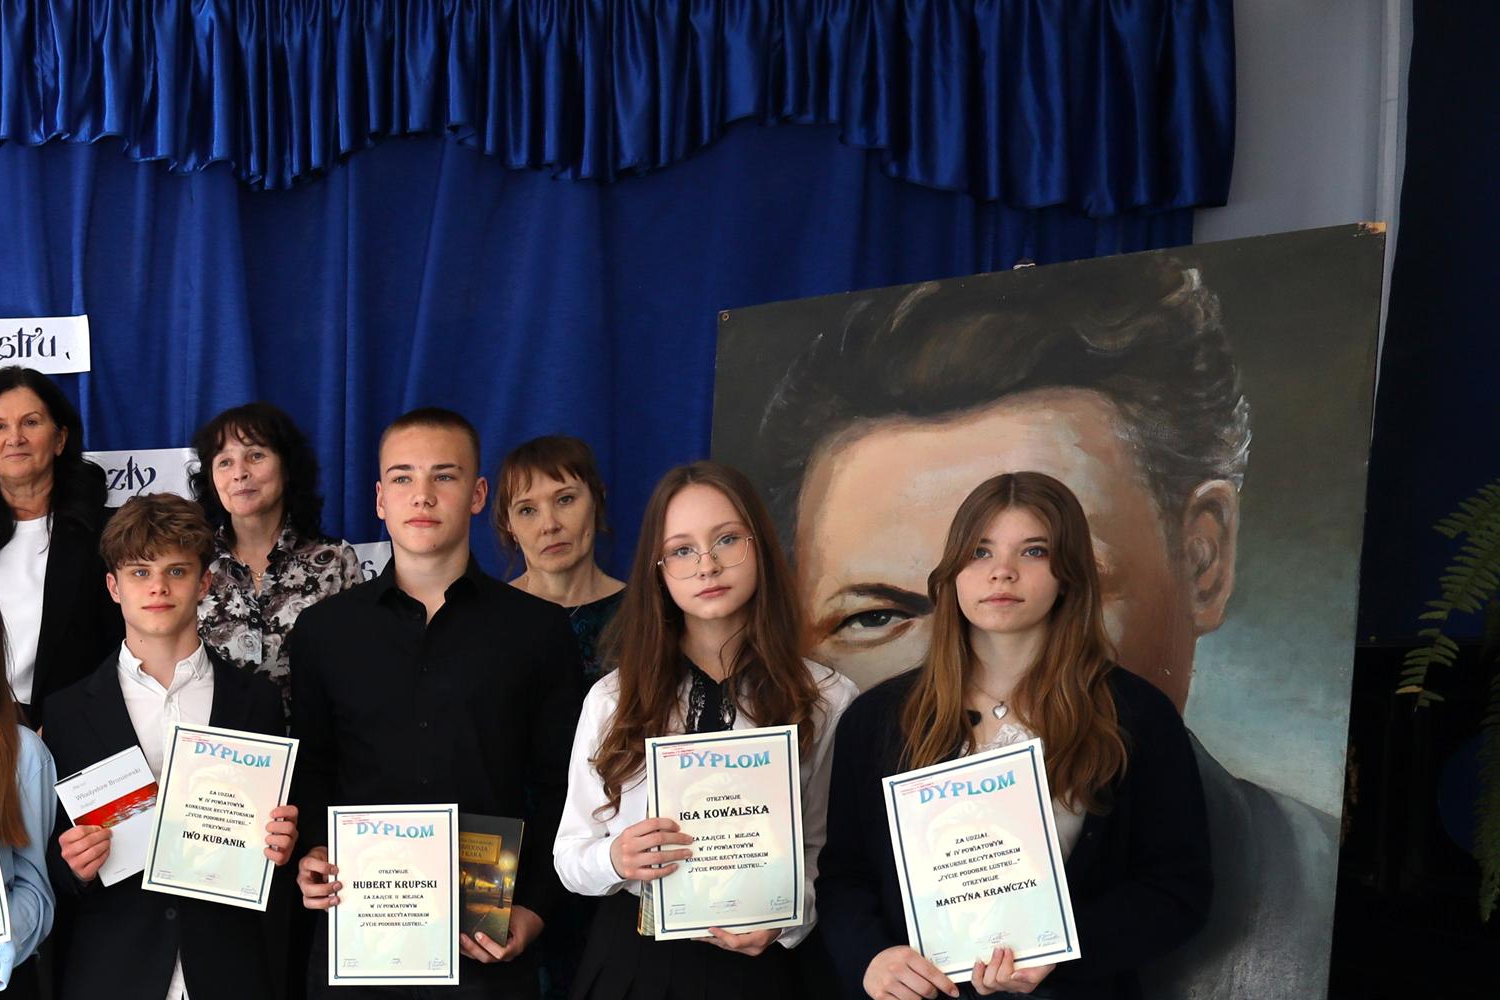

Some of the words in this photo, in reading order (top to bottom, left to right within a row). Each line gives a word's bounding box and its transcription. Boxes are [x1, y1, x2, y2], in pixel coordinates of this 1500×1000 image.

[194, 741, 271, 768] DYPLOM
[680, 750, 772, 769] DYPLOM
[920, 769, 1016, 804] DYPLOM
[706, 794, 741, 802] OTRZYMUJE
[679, 811, 701, 821] IGA
[704, 805, 769, 819] KOWALSKA
[356, 820, 435, 838] DYPLOM
[182, 830, 201, 840] IWO
[202, 833, 246, 848] KUBANIK
[713, 842, 754, 850] POWIATOWYM
[961, 840, 1004, 854] POWIATOWYM
[719, 852, 769, 860] RECYTATORSKIM
[933, 859, 967, 871] KONKURSIE
[968, 847, 1021, 863] RECYTATORSKIM
[959, 866, 988, 876] PODOBNE
[353, 880, 392, 889] HUBERT
[394, 880, 438, 888] KRUPSKI
[962, 874, 999, 887] OTRZYMUJE
[936, 891, 981, 907] MARTYNA
[983, 879, 1038, 897] KRAWCZYK
